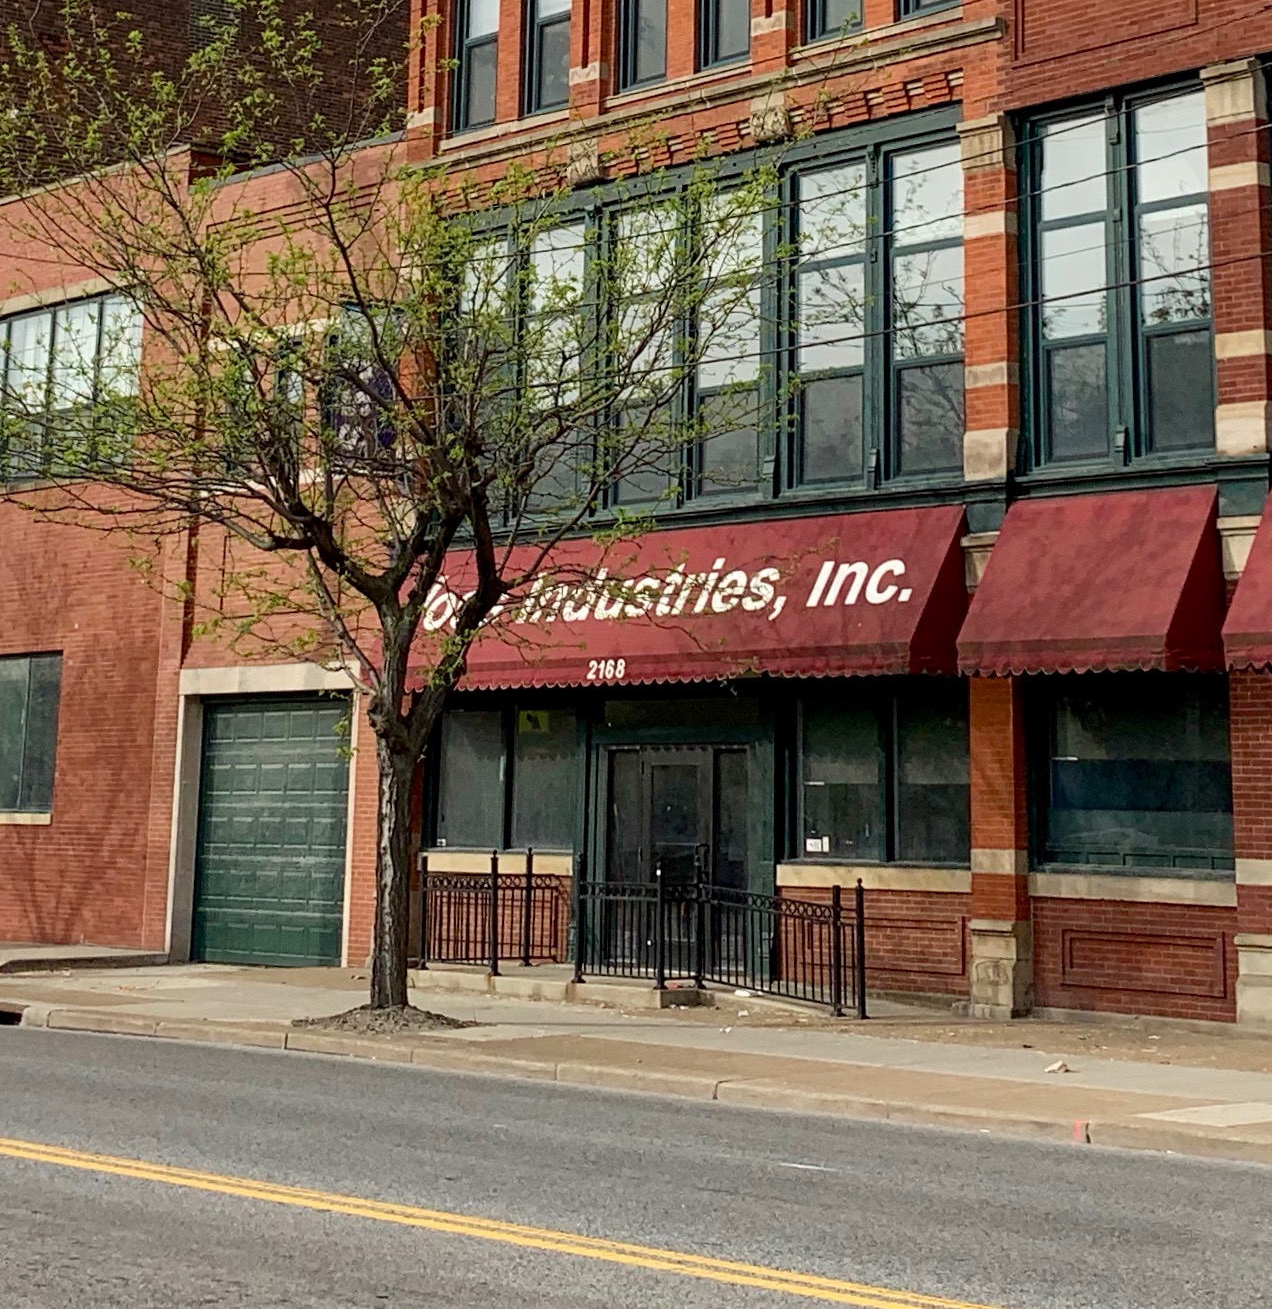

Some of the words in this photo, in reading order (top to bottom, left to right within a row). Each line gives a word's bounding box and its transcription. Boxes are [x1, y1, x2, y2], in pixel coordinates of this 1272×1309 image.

[514, 557, 787, 622] Industries,
[806, 558, 915, 608] Inc.
[587, 658, 626, 681] 2168
